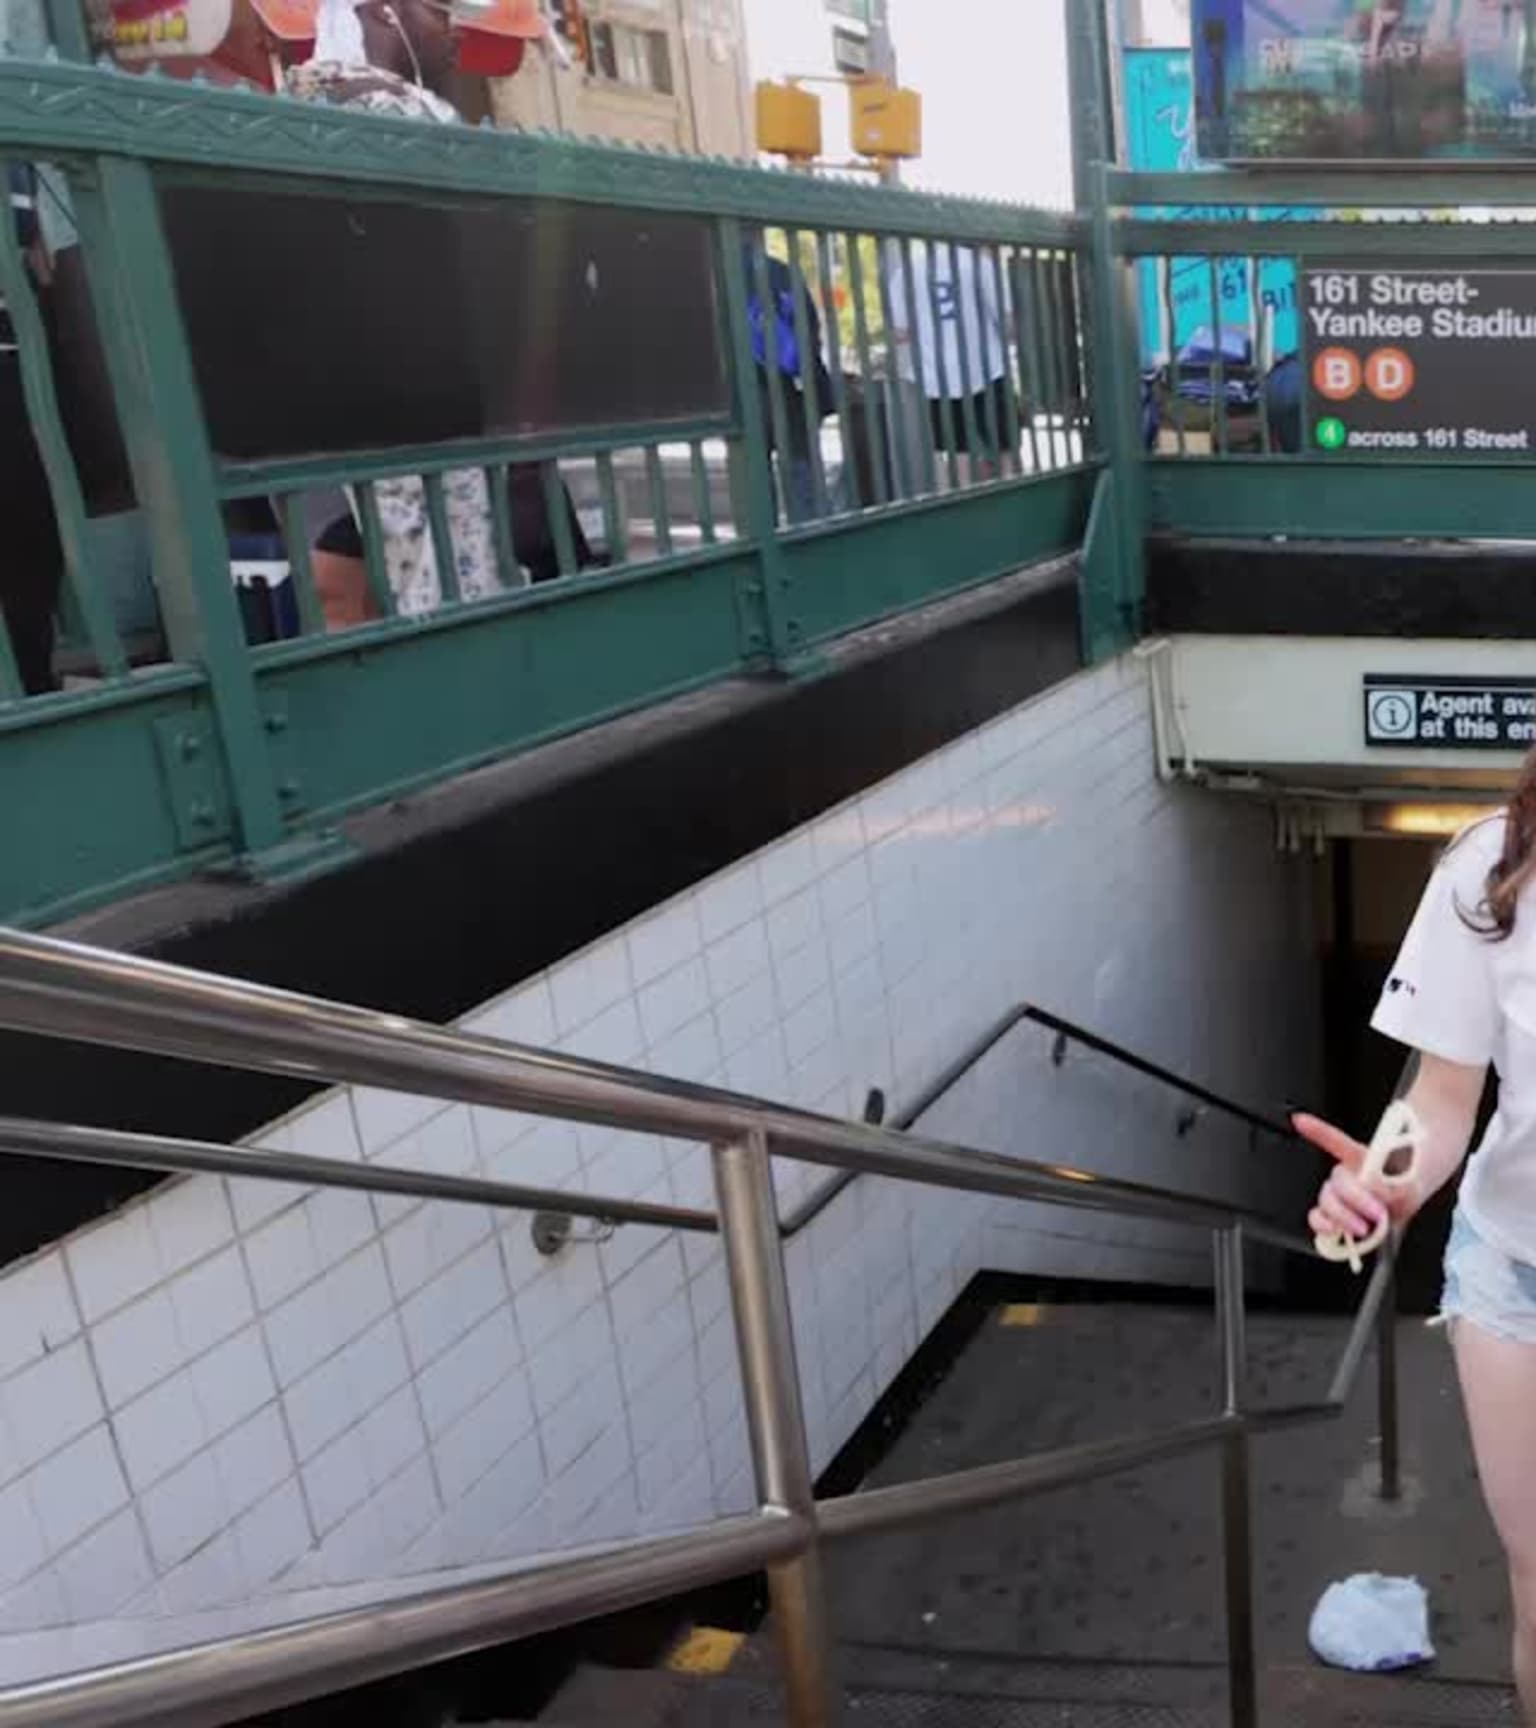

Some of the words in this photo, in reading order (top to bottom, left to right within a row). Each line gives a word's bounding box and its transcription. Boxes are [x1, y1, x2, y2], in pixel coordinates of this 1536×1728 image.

[1309, 275, 1359, 304] 161
[1370, 275, 1479, 305] Street-
[1308, 307, 1423, 338] Yankee
[1323, 357, 1351, 390] B
[1376, 357, 1404, 390] D
[1348, 431, 1418, 448] across
[1423, 429, 1457, 447] 161
[1463, 428, 1529, 449] Street
[1420, 690, 1494, 718] Agent
[1502, 696, 1536, 715] ava
[1420, 717, 1446, 738] at
[1454, 715, 1499, 739] this
[1507, 721, 1536, 740] en
